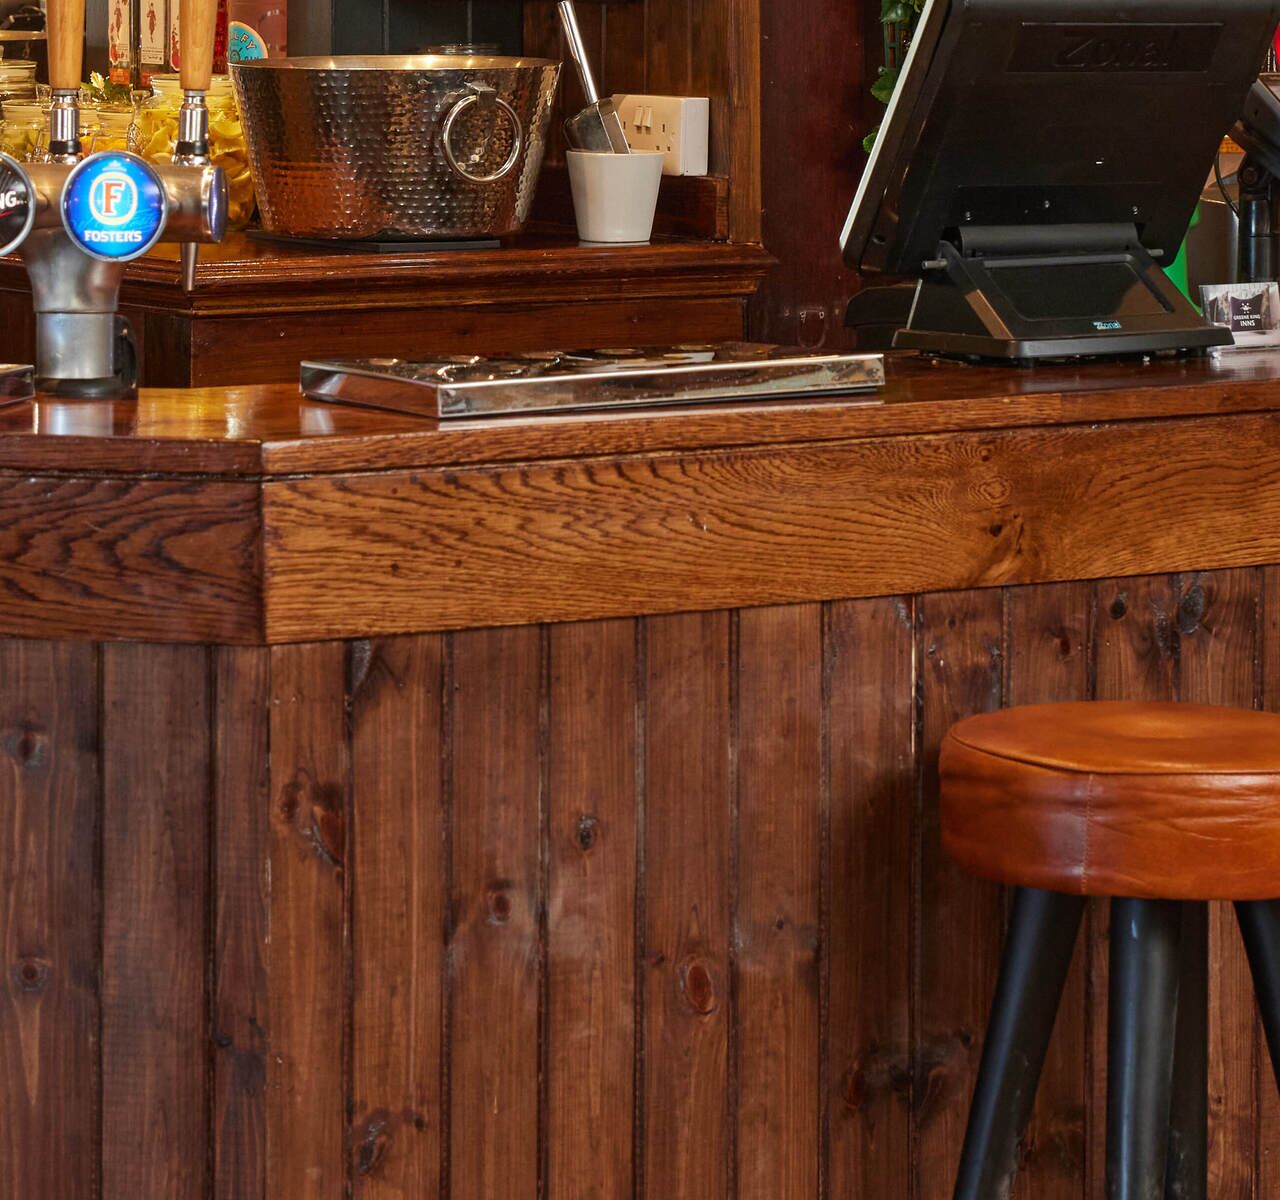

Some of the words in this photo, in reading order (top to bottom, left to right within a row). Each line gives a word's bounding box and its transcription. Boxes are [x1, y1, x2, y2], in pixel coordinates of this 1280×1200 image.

[229, 29, 256, 50] LFY
[102, 181, 124, 217] F
[83, 228, 143, 243] FOSTER'S
